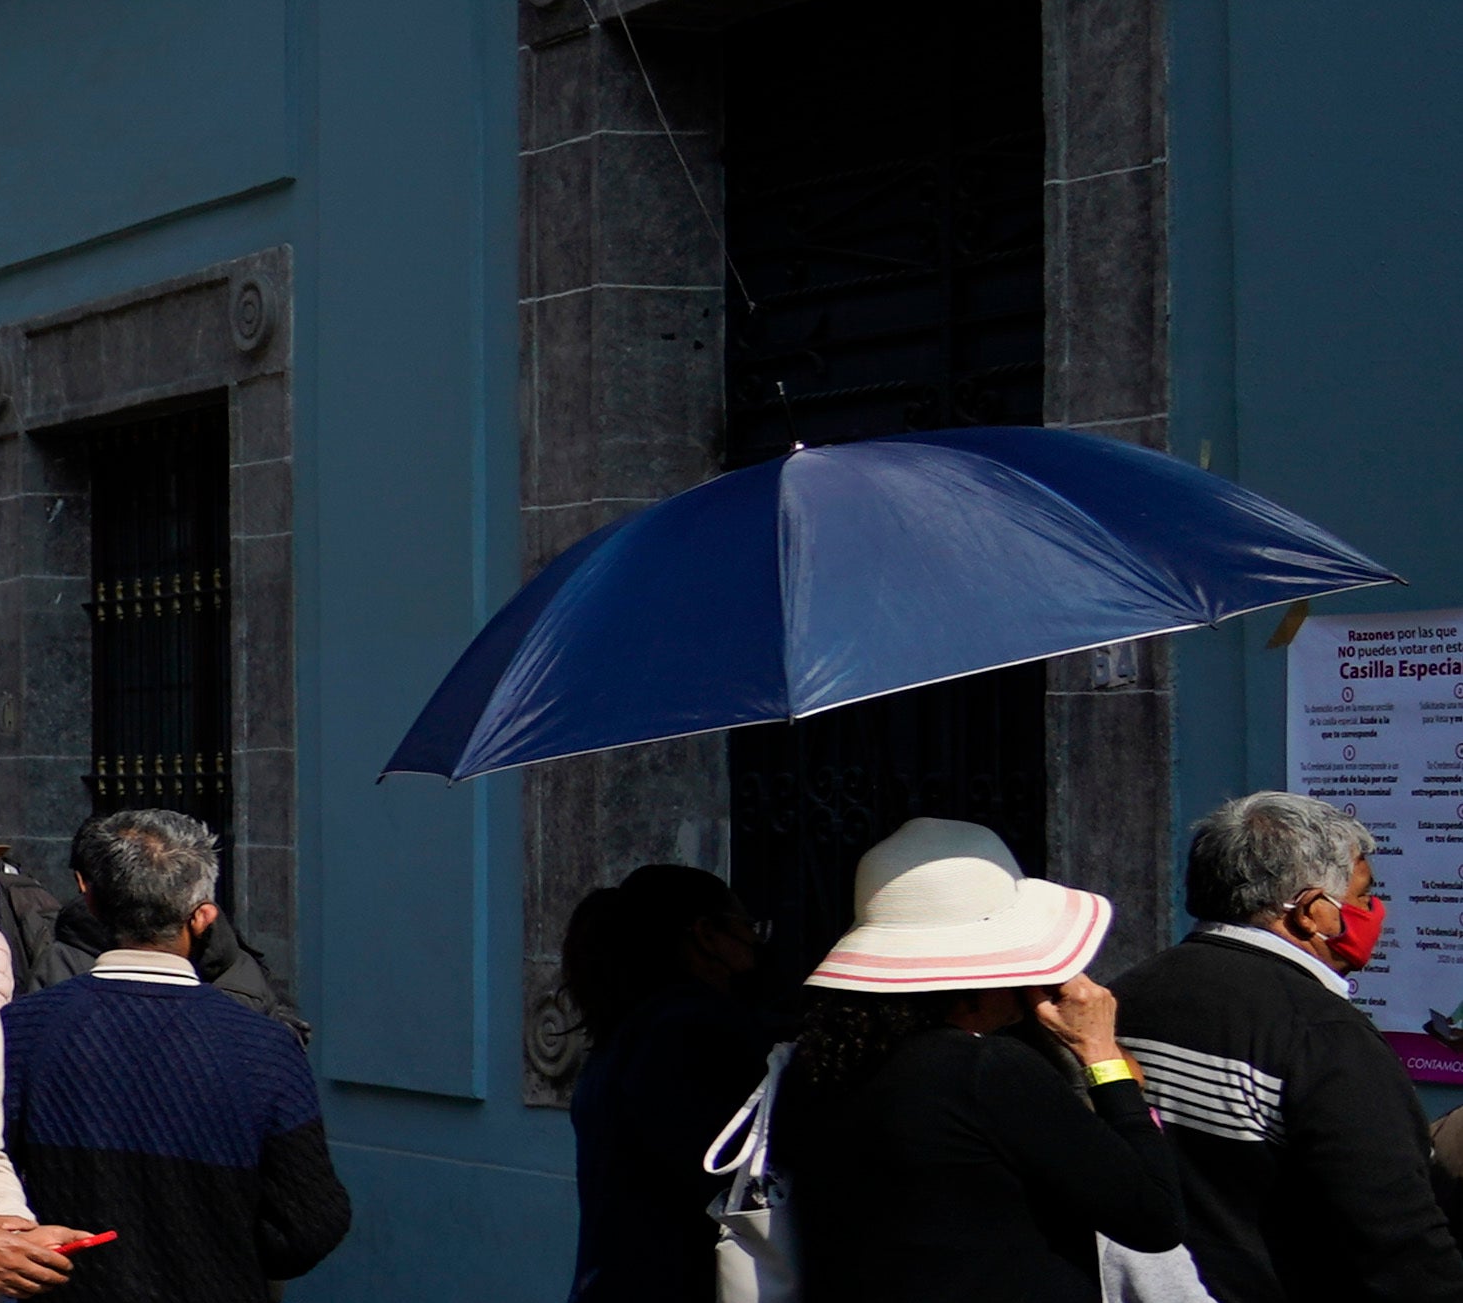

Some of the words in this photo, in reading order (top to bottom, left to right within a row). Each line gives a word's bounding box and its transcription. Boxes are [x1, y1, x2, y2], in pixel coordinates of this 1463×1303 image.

[1348, 630, 1395, 642] Razones
[1397, 630, 1415, 643] por
[1418, 626, 1434, 638] las
[1436, 627, 1458, 641] que
[1338, 646, 1356, 658] NO
[1358, 646, 1397, 660] puedes
[1399, 644, 1428, 655] votar
[1430, 645, 1443, 654] en
[1446, 642, 1463, 654] est
[1340, 660, 1394, 679] Casilla
[1399, 658, 1463, 681] Especia
[1321, 731, 1332, 740] que
